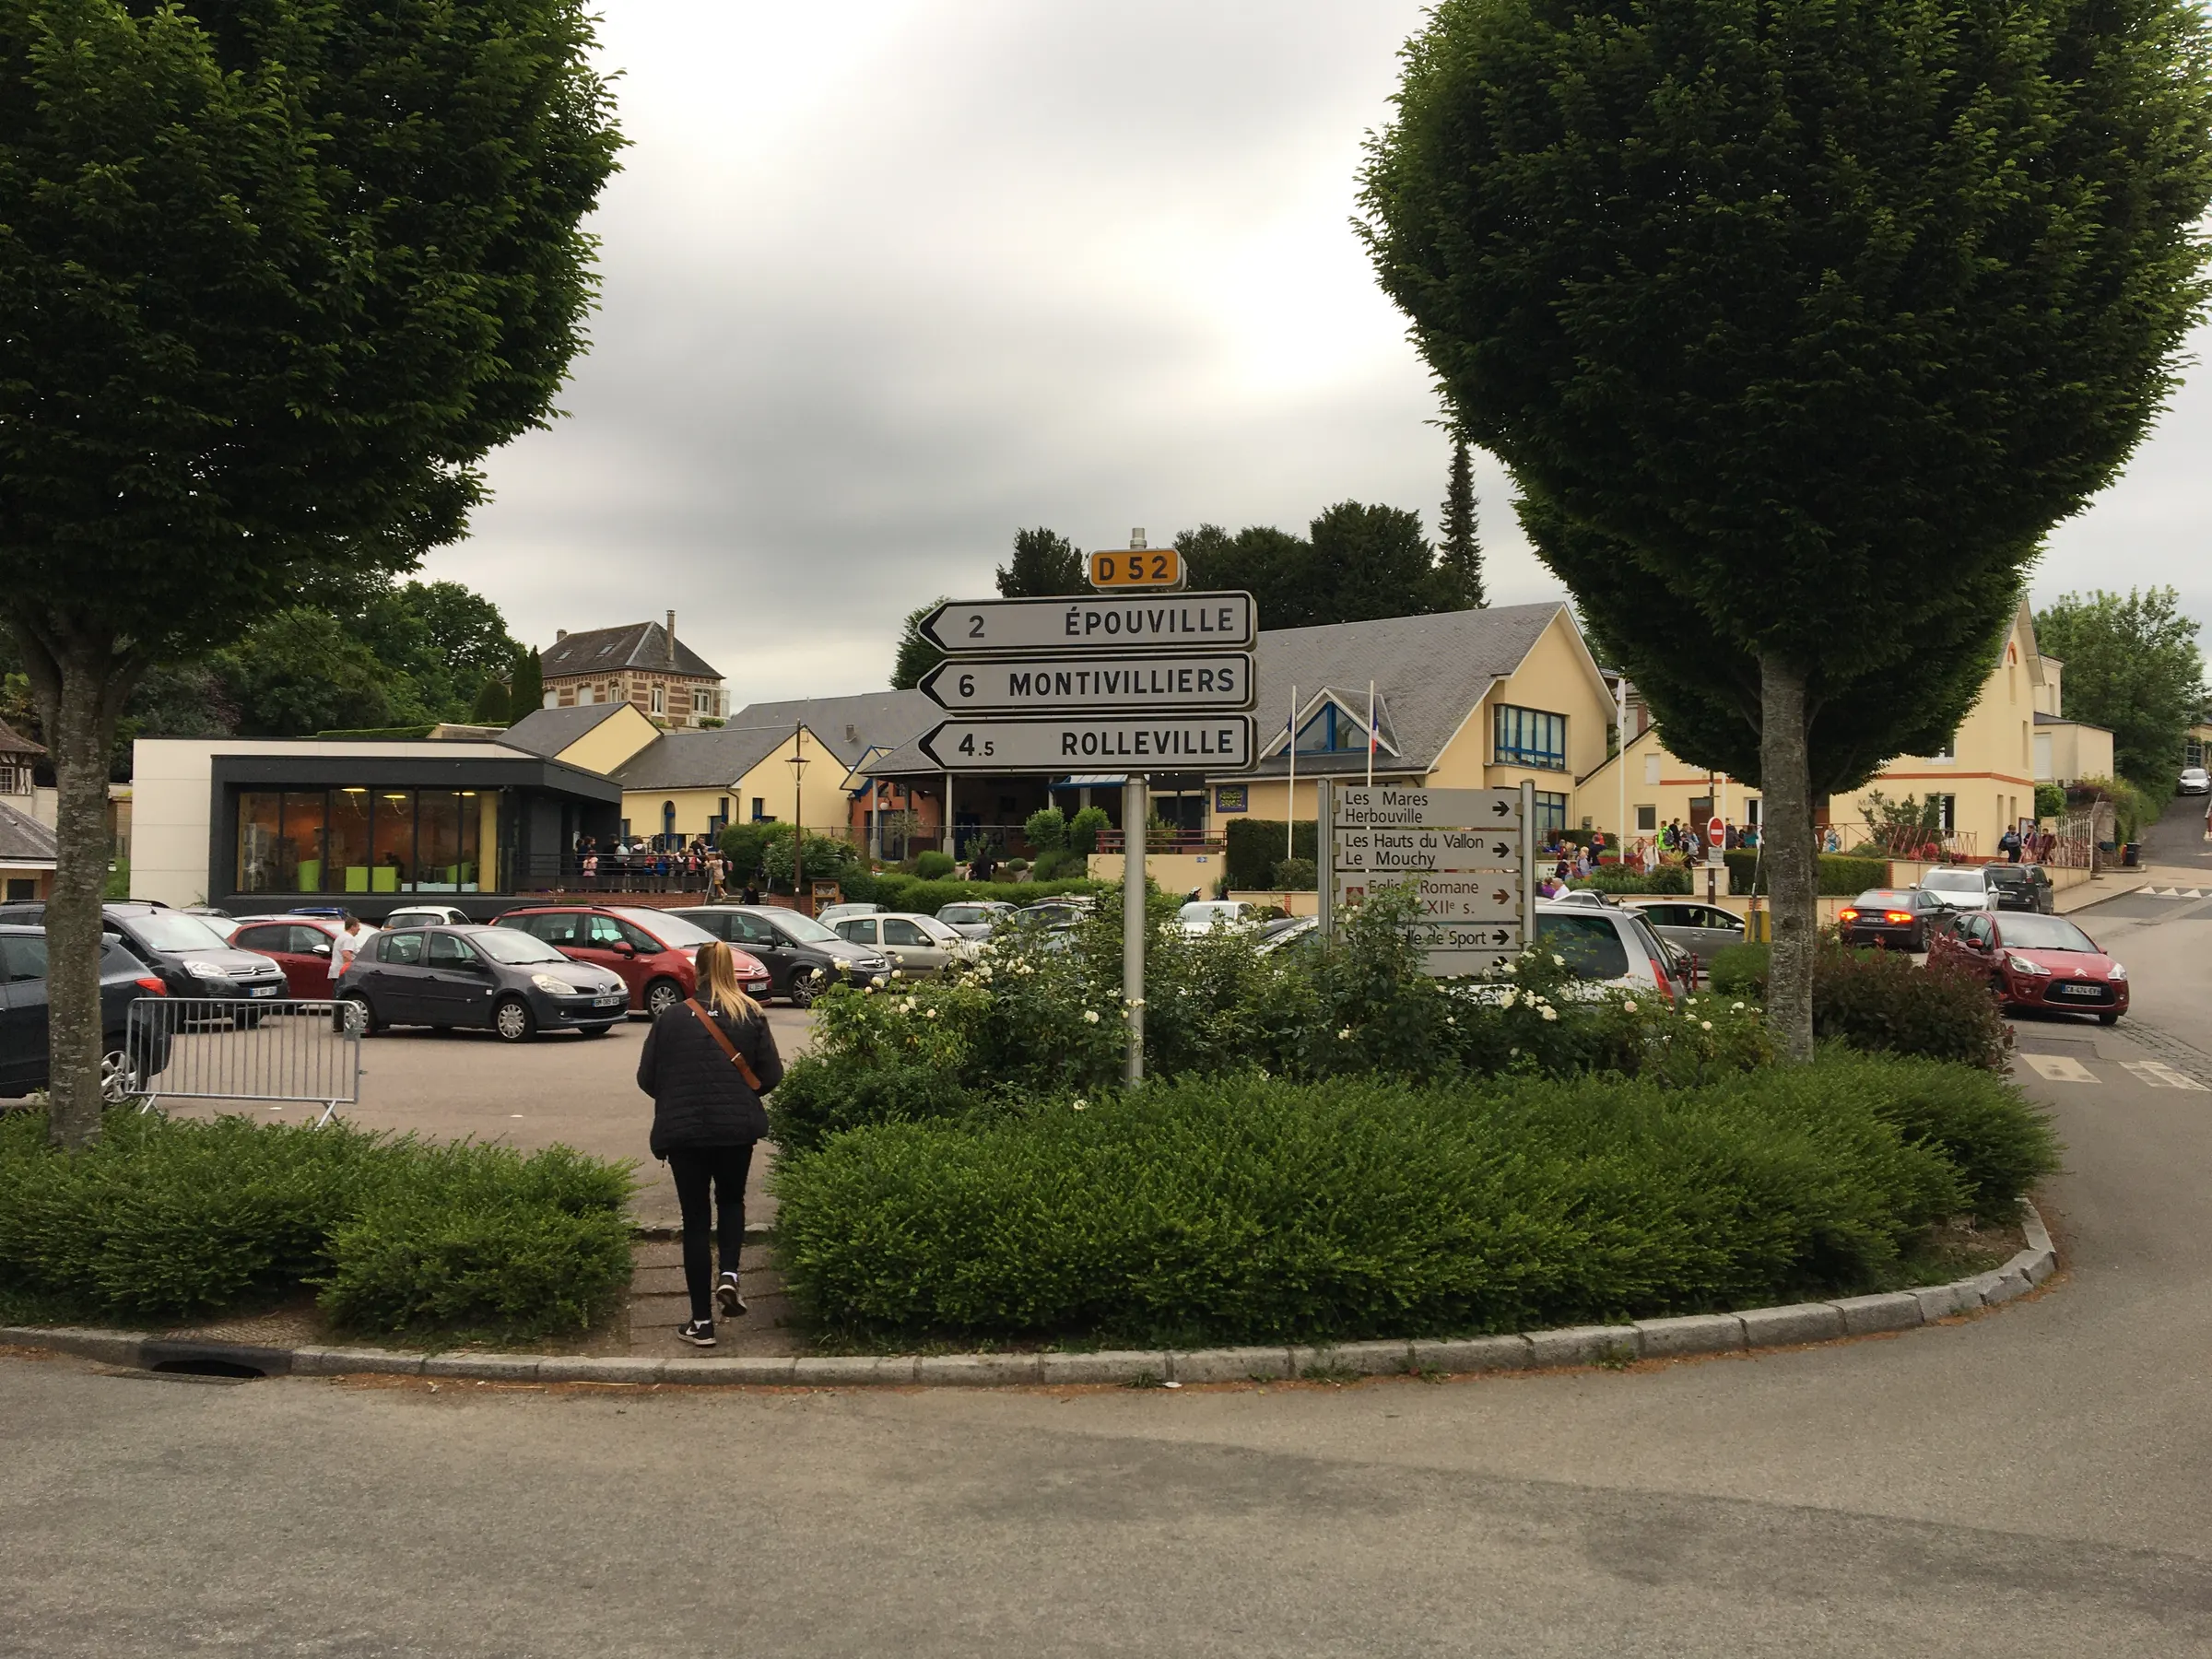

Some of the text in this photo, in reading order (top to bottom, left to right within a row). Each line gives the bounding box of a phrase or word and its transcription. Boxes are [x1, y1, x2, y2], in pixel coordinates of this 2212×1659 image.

[1100, 555, 1169, 581] D 52
[969, 606, 1233, 638] 2 ÉPOUVILLE
[959, 668, 1234, 698] 6 MONTIVILLIERS
[959, 730, 1233, 757] 4.5 ROLLEVILLE
[1346, 791, 1429, 806] Les Mares
[1346, 808, 1423, 824] Herbouville
[1346, 833, 1484, 849] Les Hauts du Vallon
[1346, 852, 1436, 869] Le Mouchy
[1420, 880, 1479, 894] Romane
[1449, 931, 1487, 948] Sport
